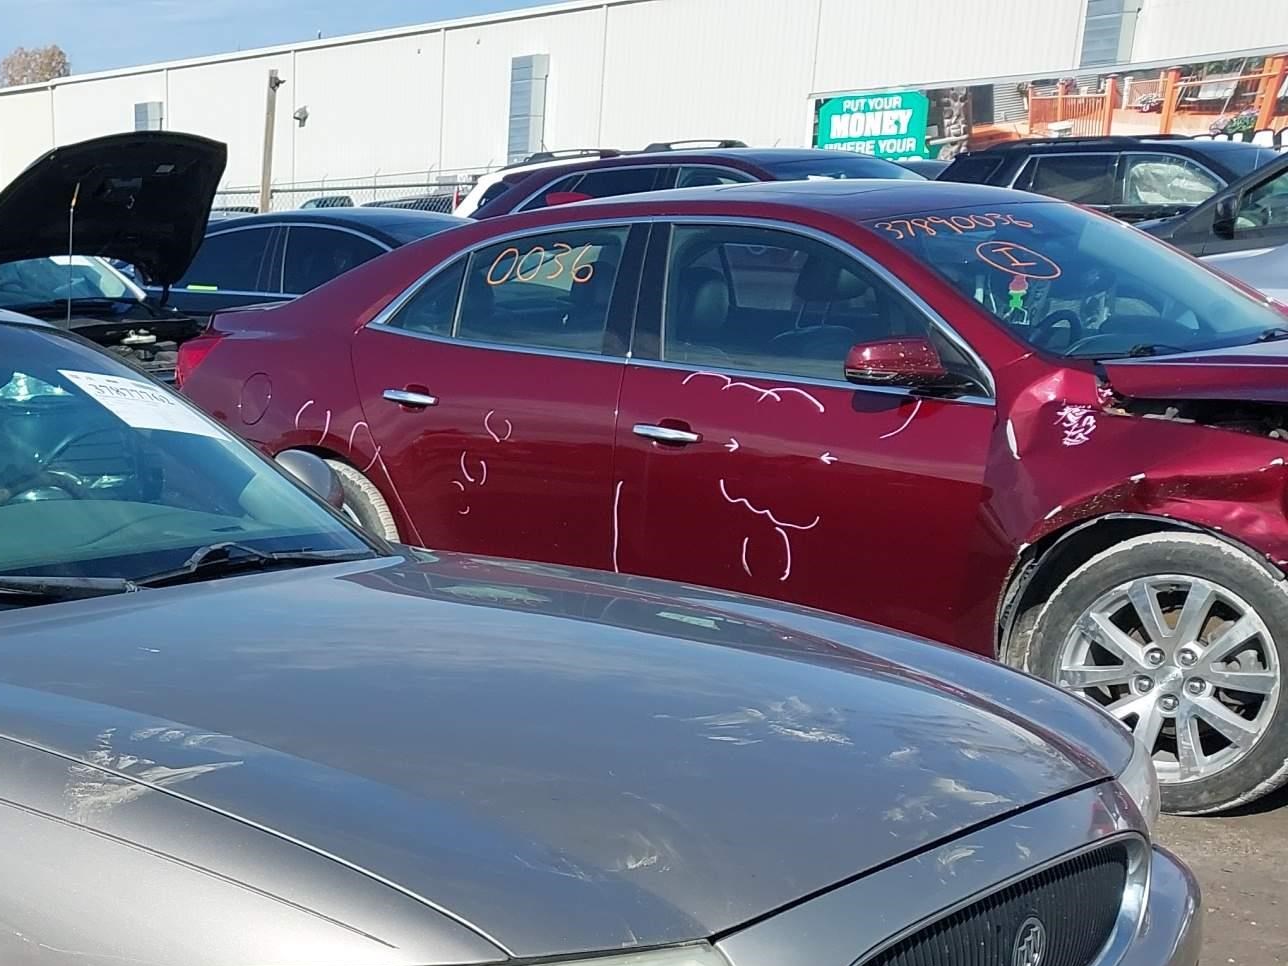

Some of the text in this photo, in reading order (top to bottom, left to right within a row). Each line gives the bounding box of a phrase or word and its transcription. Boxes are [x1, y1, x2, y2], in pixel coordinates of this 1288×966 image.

[843, 95, 902, 112] PUT YOUR
[830, 108, 912, 139] MONEY
[878, 137, 916, 153] YOUR
[875, 213, 1033, 240] 37890036
[487, 242, 594, 285] 0036
